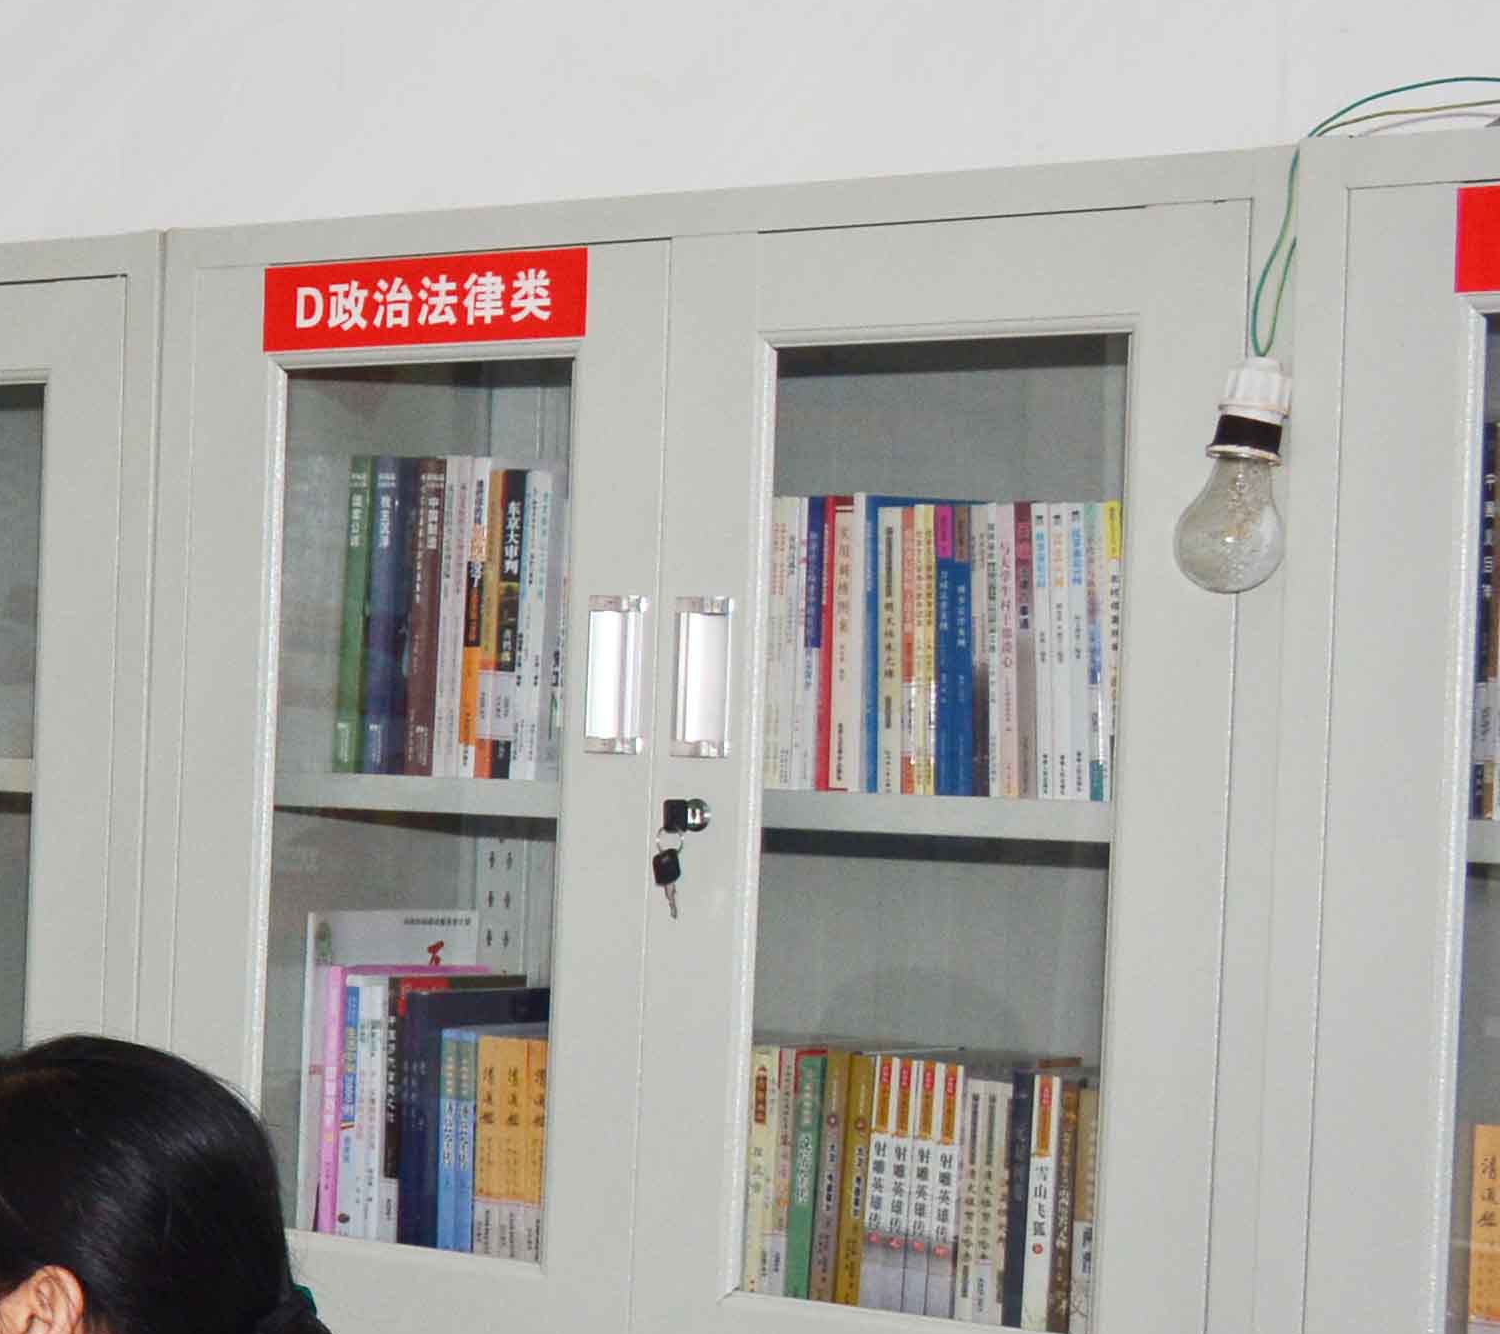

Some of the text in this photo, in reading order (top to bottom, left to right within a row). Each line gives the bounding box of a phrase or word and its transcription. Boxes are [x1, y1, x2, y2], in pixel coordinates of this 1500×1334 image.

[296, 267, 553, 330] D政治法律类
